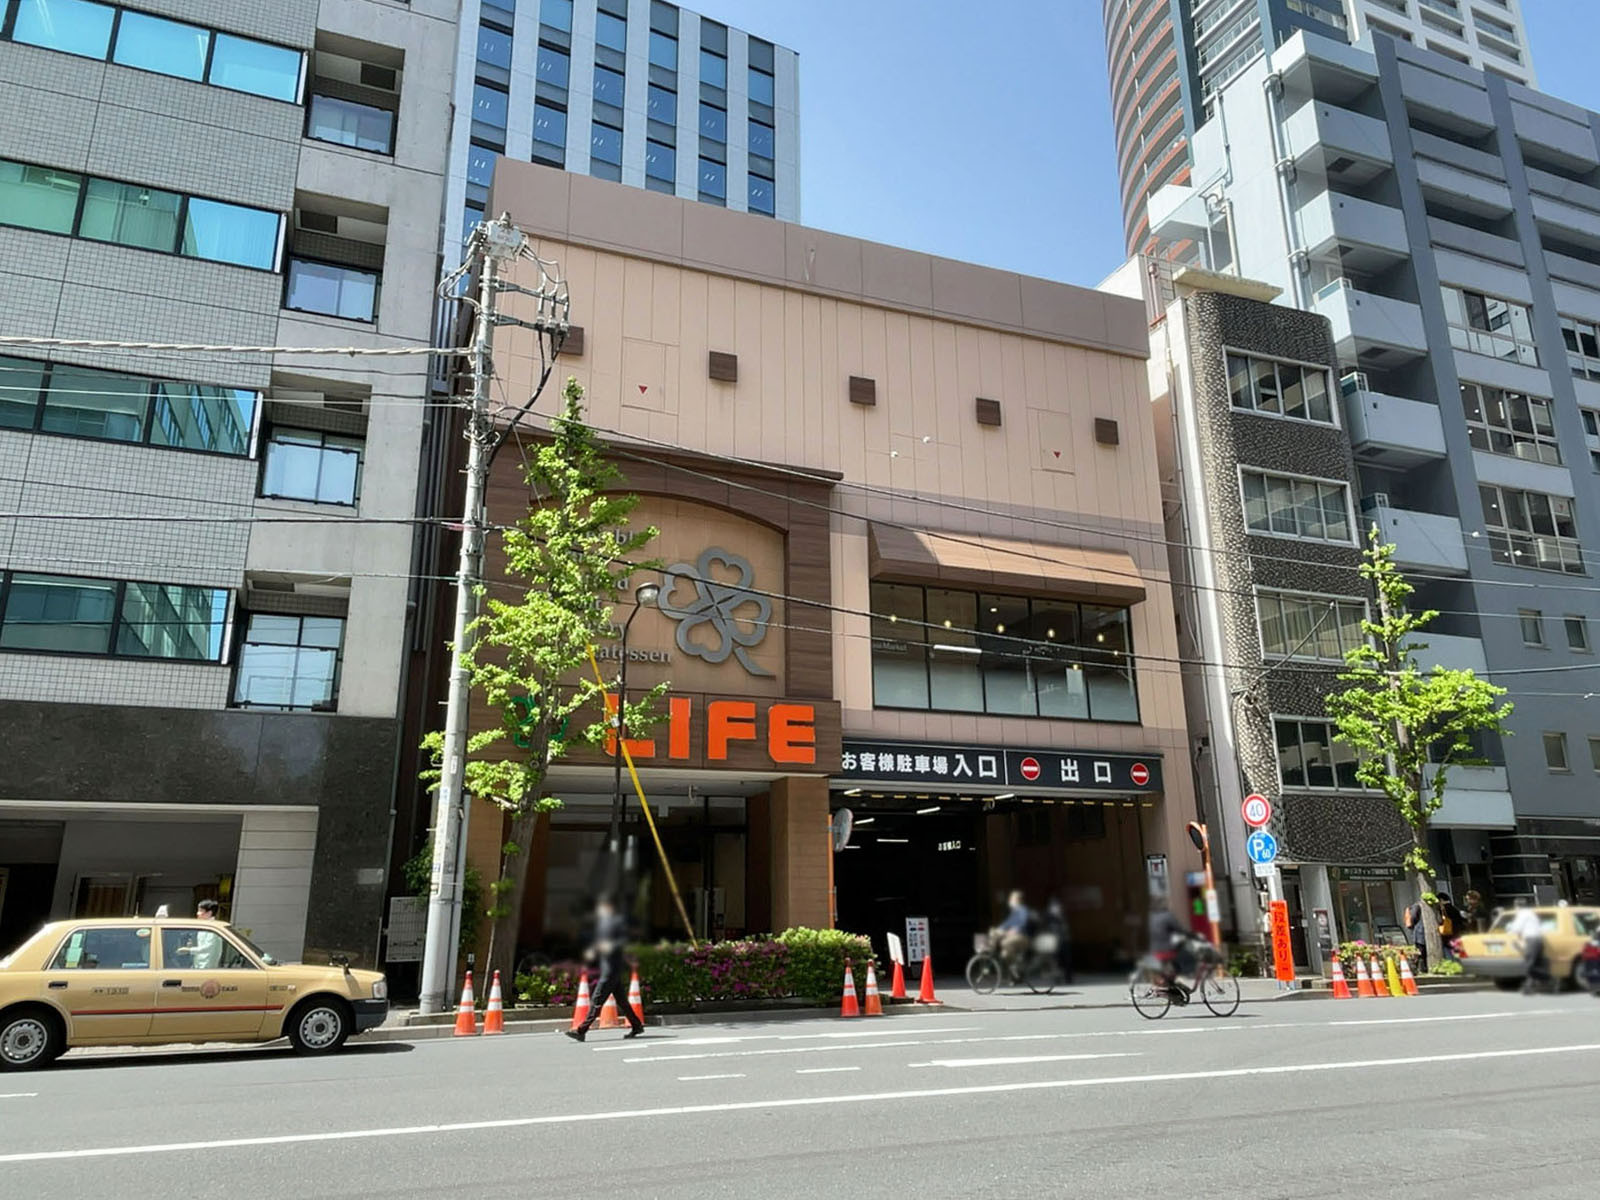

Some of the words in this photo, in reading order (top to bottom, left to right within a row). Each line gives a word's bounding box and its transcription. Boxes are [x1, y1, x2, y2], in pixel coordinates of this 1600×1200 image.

[602, 693, 816, 764] LIFE
[1060, 758, 1112, 783] 出口
[1249, 802, 1264, 817] 40
